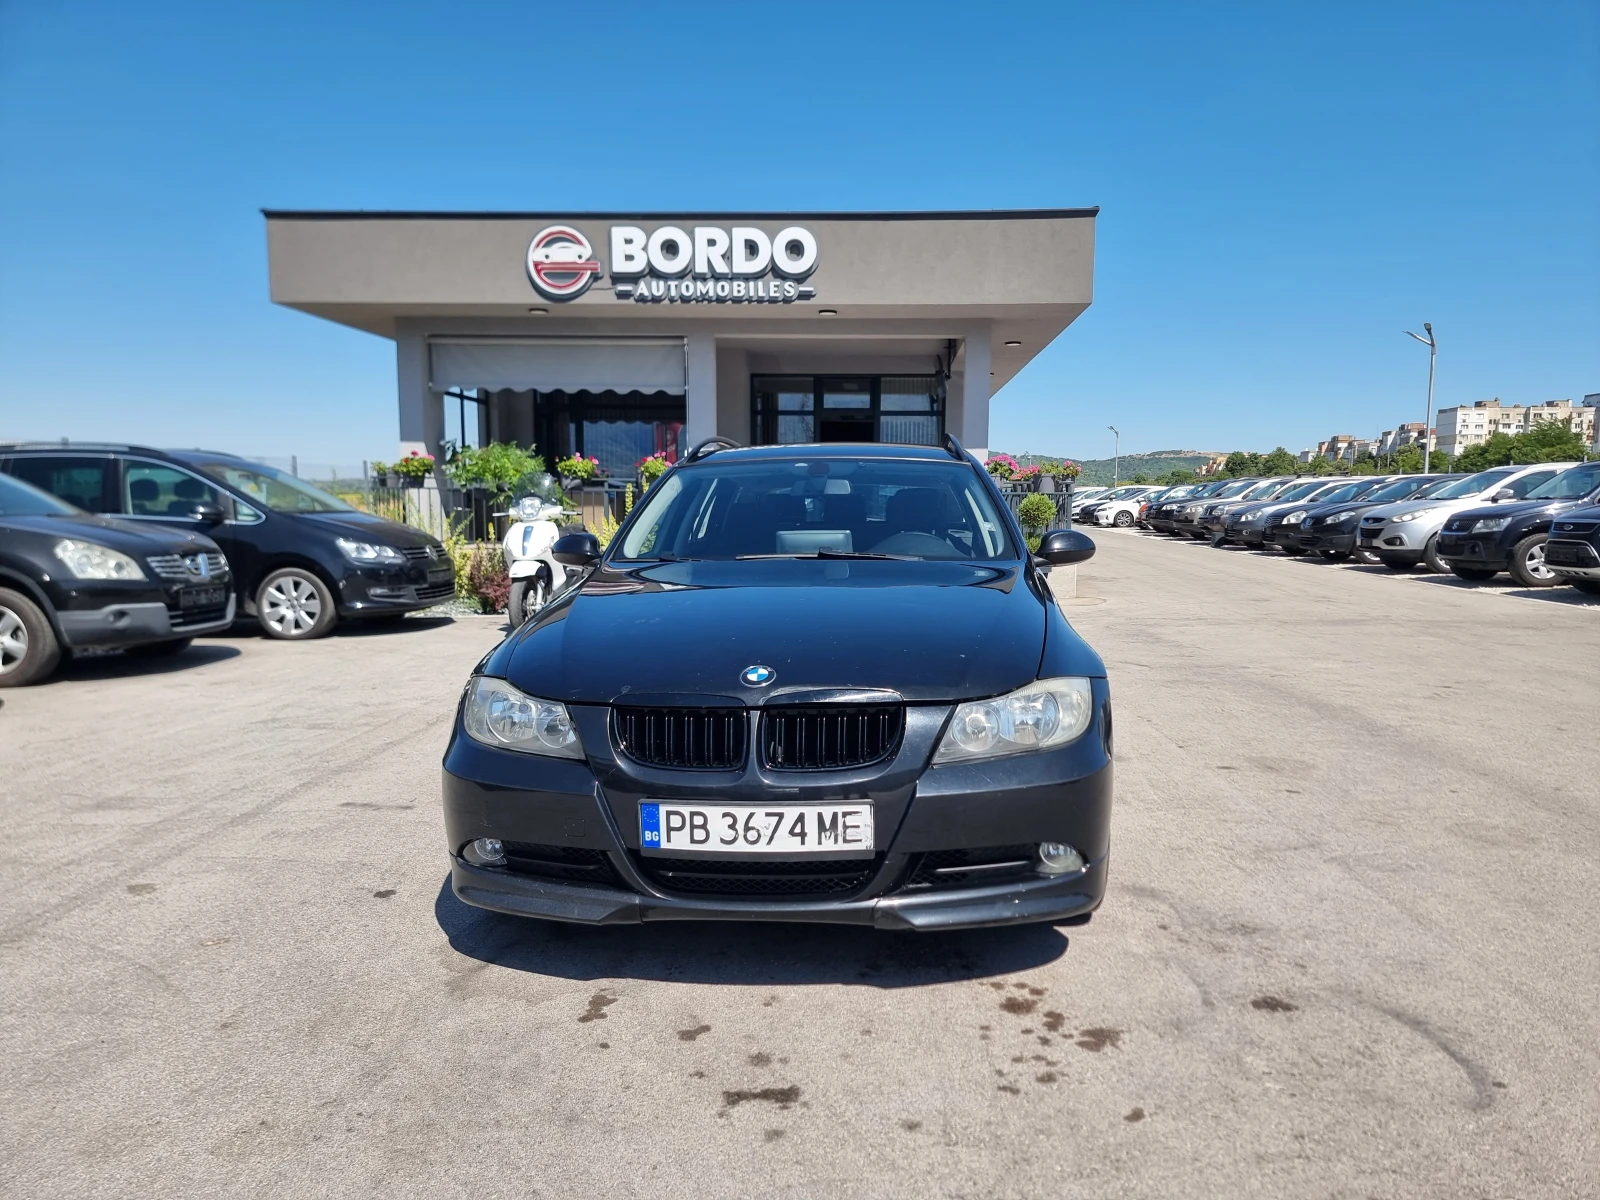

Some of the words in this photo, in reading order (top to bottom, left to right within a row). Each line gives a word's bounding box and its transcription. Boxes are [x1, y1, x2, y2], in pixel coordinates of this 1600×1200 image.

[610, 226, 818, 275] BORDO
[636, 281, 795, 297] AUTOMOBILES
[644, 830, 660, 842] BG
[665, 810, 711, 845] PB
[719, 811, 808, 846] 3674
[817, 810, 863, 846] ME
